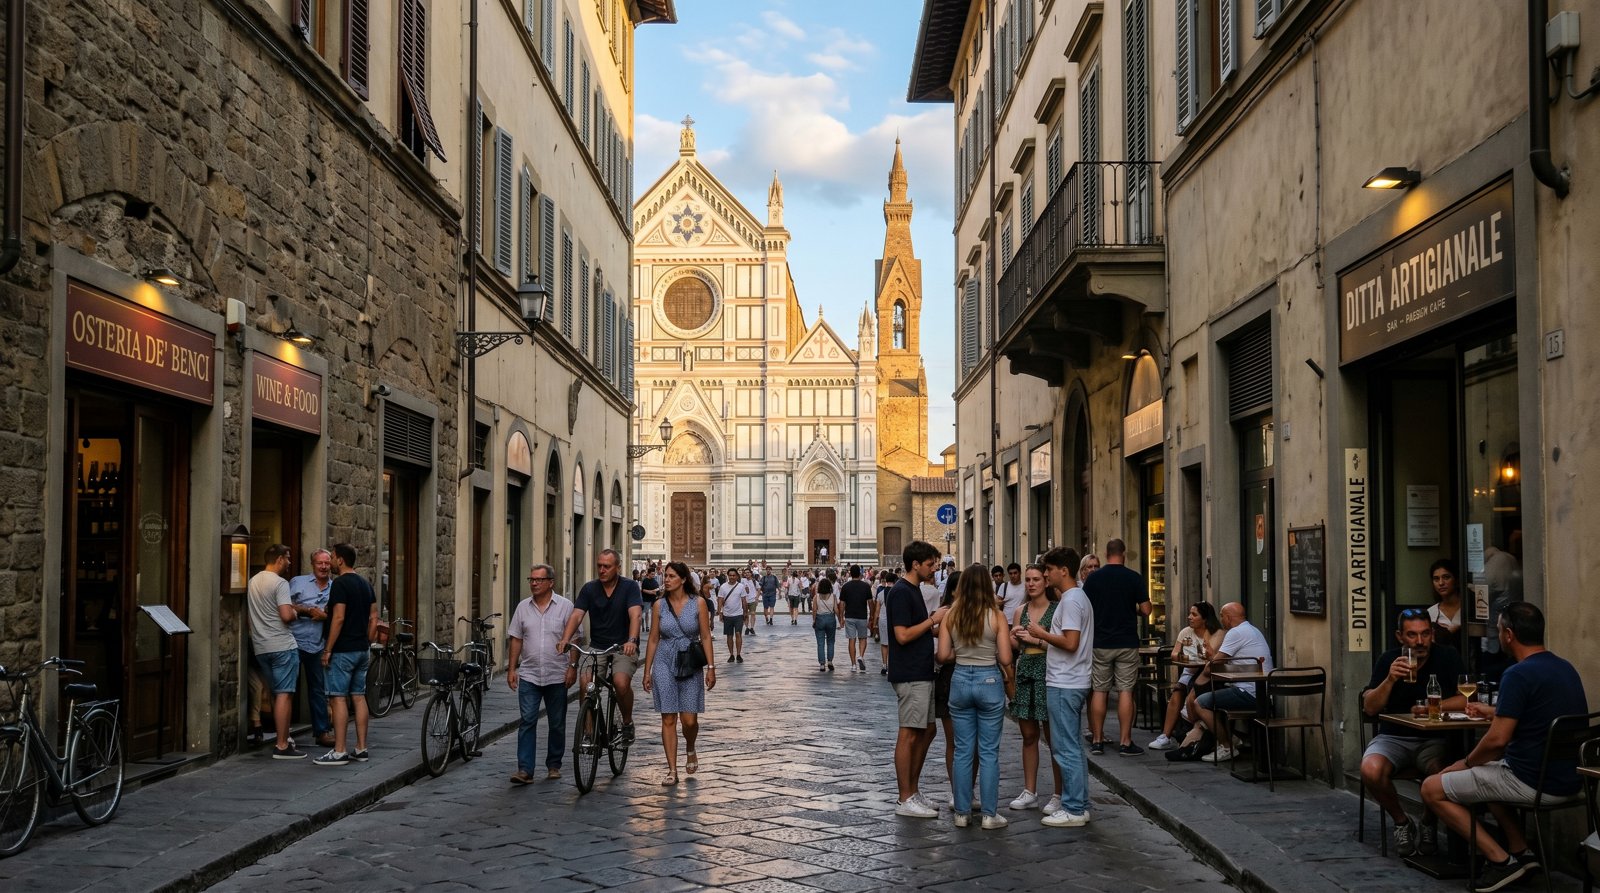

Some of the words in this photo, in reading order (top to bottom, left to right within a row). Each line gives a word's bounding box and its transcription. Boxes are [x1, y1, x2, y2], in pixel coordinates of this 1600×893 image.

[1346, 275, 1384, 331] DITTA
[1390, 211, 1503, 311] ARTIGIANALE
[73, 310, 141, 361] OSTERIA
[145, 334, 168, 368] DE'
[171, 343, 210, 382] BENCI
[1549, 335, 1560, 354] 15
[256, 373, 283, 405] WINE
[284, 384, 292, 408] &
[293, 386, 319, 416] FOOD
[1349, 477, 1367, 582] ARTIGIANALE
[1352, 585, 1367, 630] DITTA
